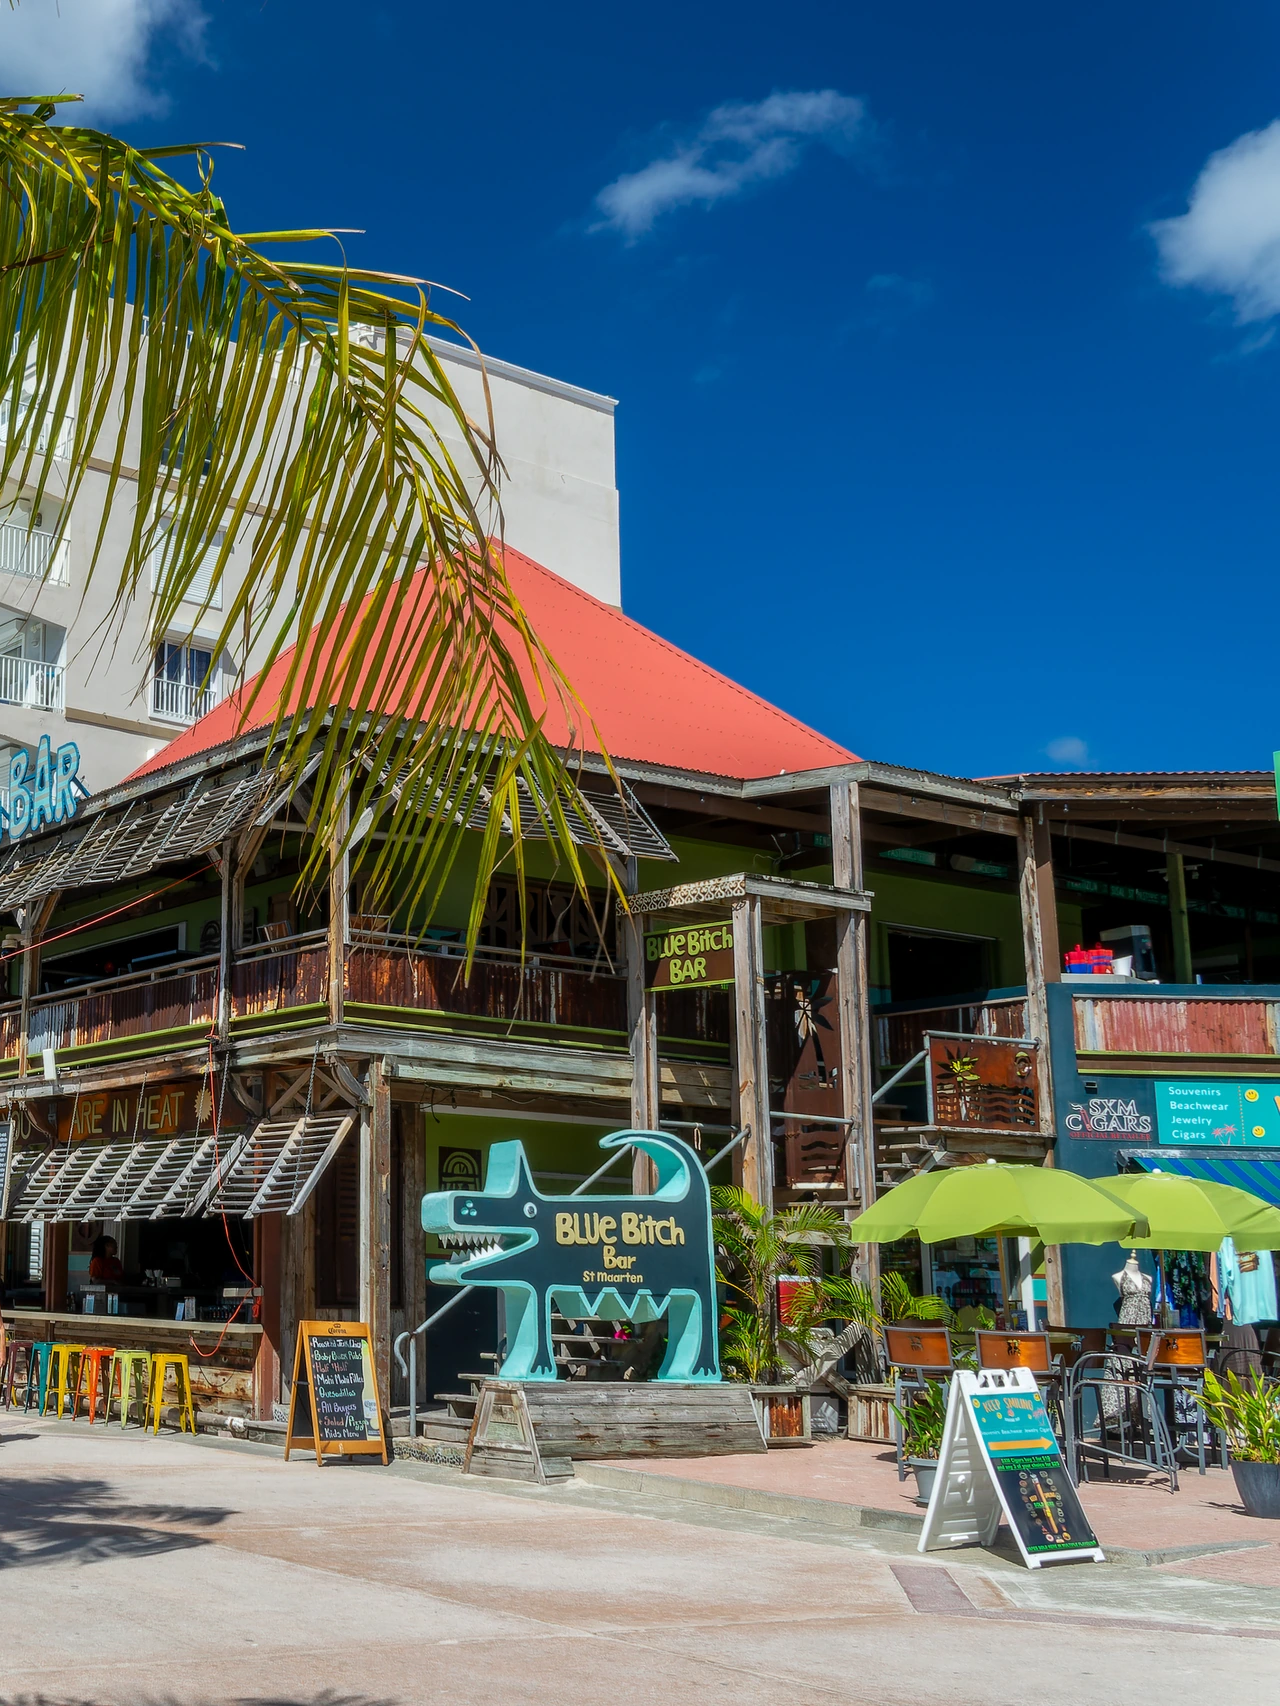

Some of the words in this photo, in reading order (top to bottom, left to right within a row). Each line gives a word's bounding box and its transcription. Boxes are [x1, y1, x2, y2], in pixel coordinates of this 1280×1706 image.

[7, 734, 81, 839] BAR
[670, 957, 707, 984] BAR
[1168, 1086, 1221, 1097] Souvenirs
[1089, 1099, 1140, 1117] SXM
[1170, 1101, 1229, 1111] Beachwear
[73, 1099, 104, 1135] ARE
[112, 1098, 128, 1133] IN
[135, 1091, 185, 1130] HEAT
[1171, 1115, 1212, 1126] Jewelry
[1172, 1129, 1206, 1140] Cigars
[621, 1212, 685, 1246] Bitch
[603, 1245, 636, 1269] Bar
[583, 1270, 595, 1283] St
[597, 1271, 644, 1283] Maarten
[328, 1327, 347, 1335] Corona
[313, 1349, 331, 1363] Baby
[348, 1350, 363, 1361] Ribs
[316, 1373, 334, 1385] Mahi
[334, 1373, 349, 1385] Mahi
[319, 1386, 356, 1398] Quesadillas
[321, 1400, 332, 1413] All
[333, 1402, 357, 1417] Burgers
[982, 1398, 1001, 1414] KEEP
[1003, 1397, 1034, 1411] SMILING
[324, 1427, 341, 1439] Kids
[342, 1428, 360, 1438] Menu
